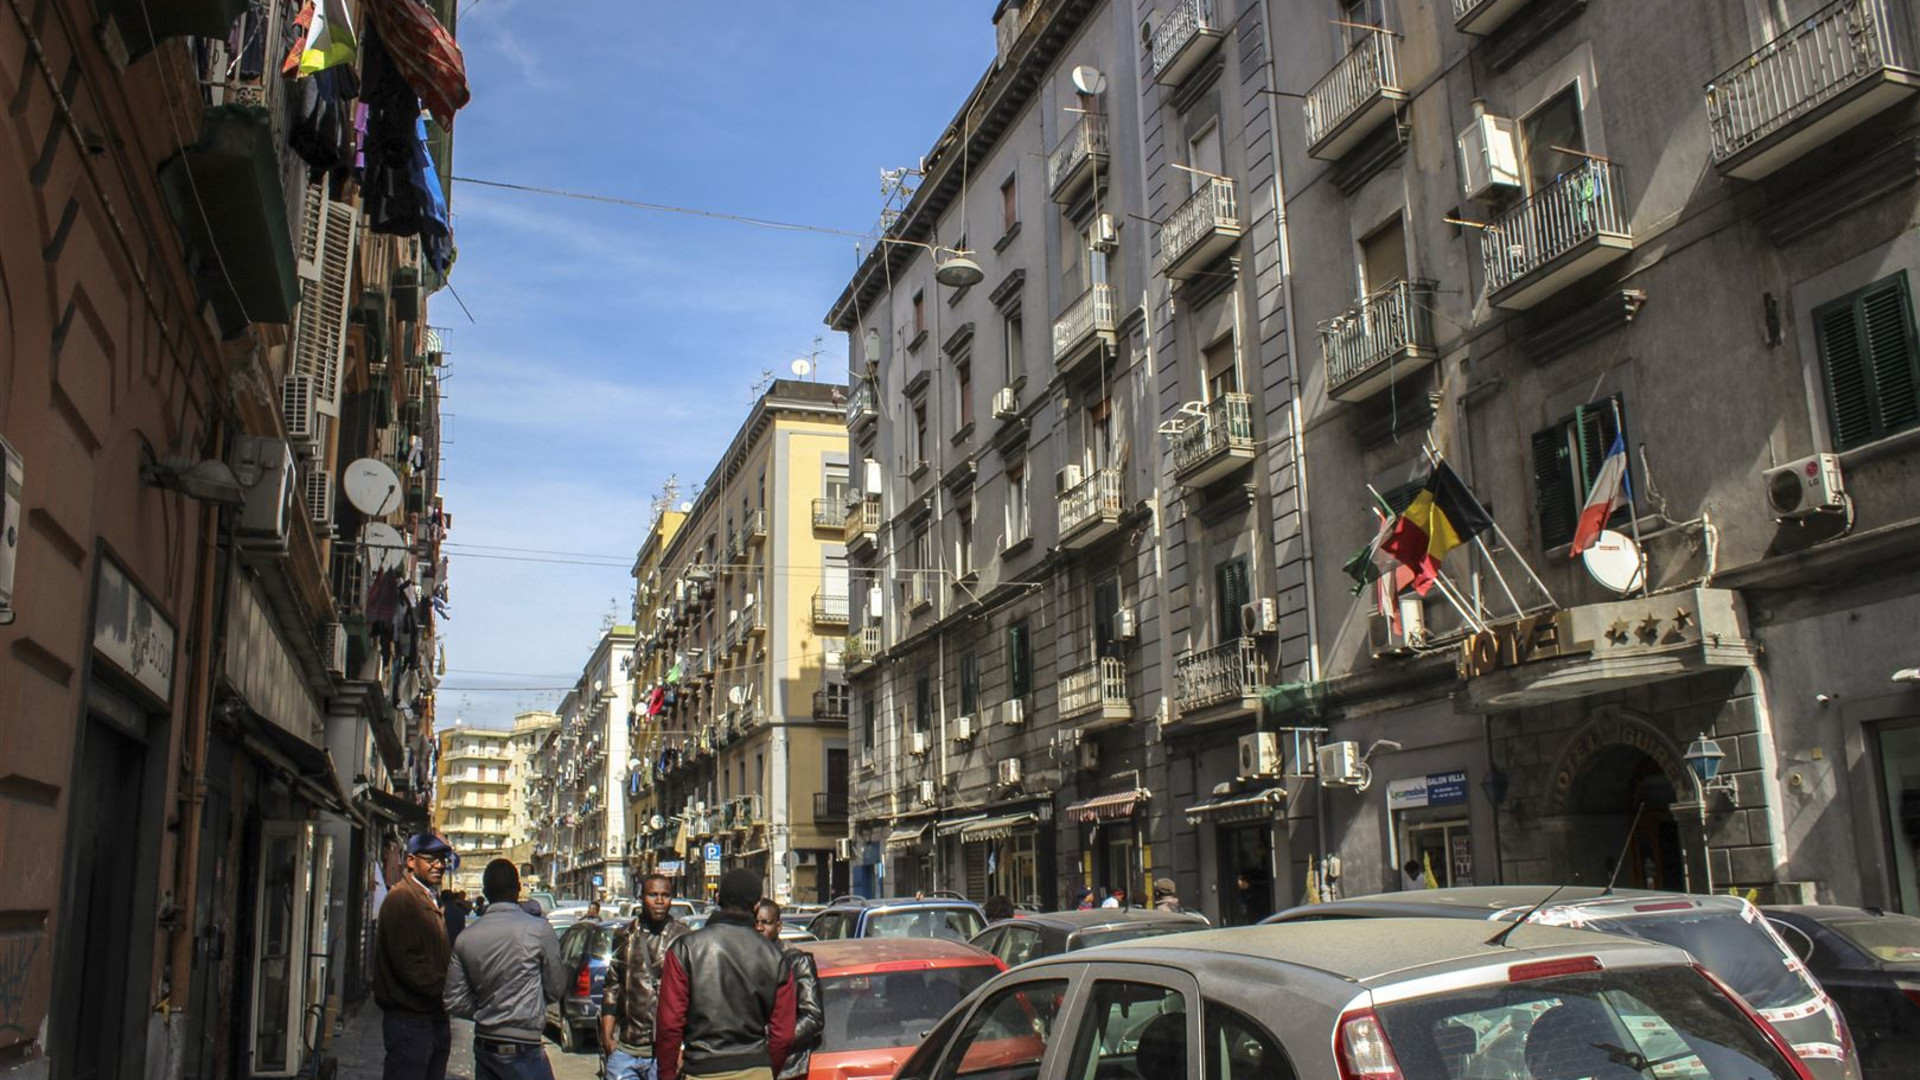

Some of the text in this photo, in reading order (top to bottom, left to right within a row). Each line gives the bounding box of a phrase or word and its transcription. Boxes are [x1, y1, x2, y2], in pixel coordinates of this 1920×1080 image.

[1808, 478, 1820, 487] LG
[1458, 609, 1596, 679] HOTEL
[1448, 773, 1466, 783] VILLA
[708, 847, 717, 859] P
